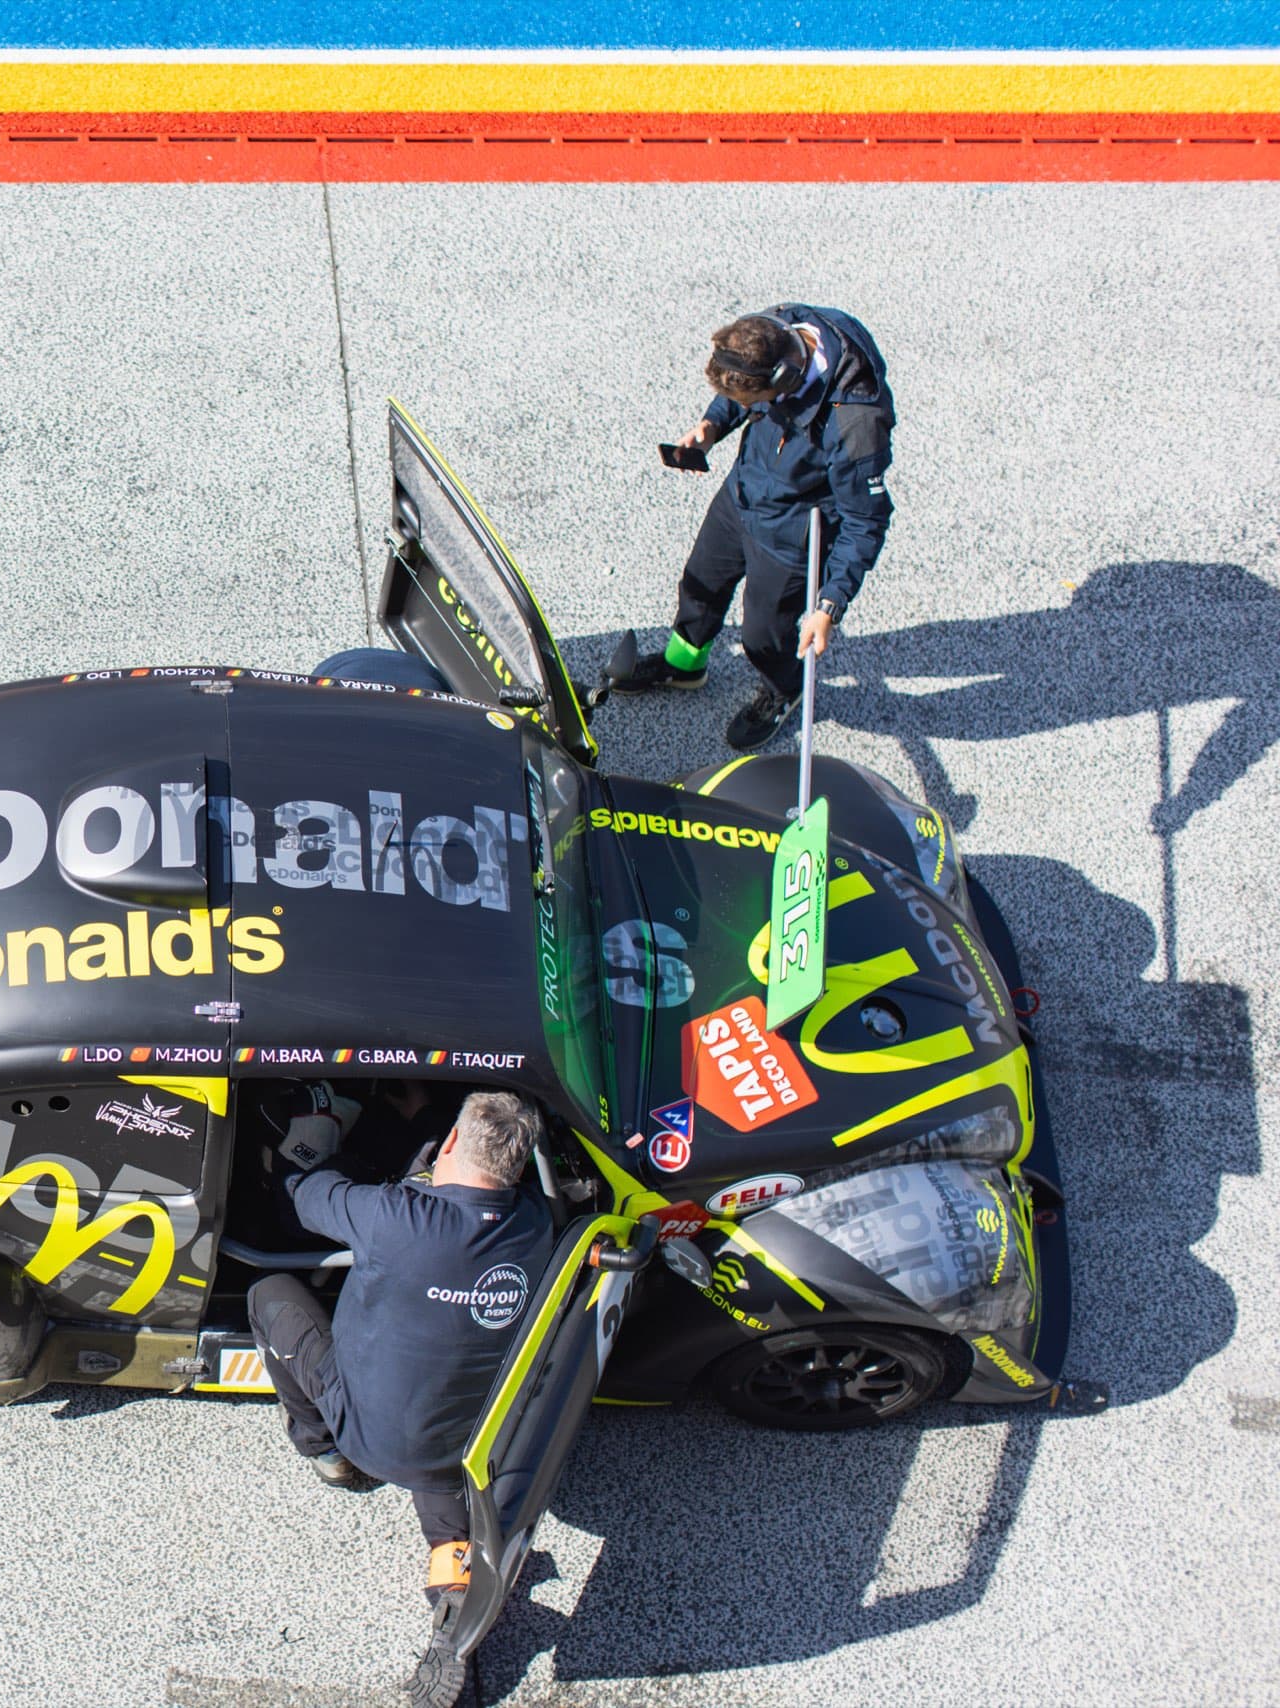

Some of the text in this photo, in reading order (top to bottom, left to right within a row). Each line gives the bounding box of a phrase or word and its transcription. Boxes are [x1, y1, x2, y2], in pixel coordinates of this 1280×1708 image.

[154, 667, 216, 677] M.ZHOU
[250, 670, 309, 685] M.BARA
[340, 679, 397, 692] G.BARA
[780, 849, 813, 983] 315
[953, 922, 1007, 1018] comtoyou
[83, 1047, 525, 1069] L.DO M.ZHOU M.BARA G.BARA F.TAQUET
[698, 1016, 775, 1122] TAPIS
[730, 1006, 800, 1106] DECO LAND
[108, 1105, 193, 1140] PHOENIX
[293, 1144, 316, 1161] OMP
[719, 1182, 789, 1209] BELL
[659, 1219, 703, 1234] PIS
[426, 1286, 519, 1308] comtoyou
[483, 1307, 514, 1317] EVENTS
[971, 1333, 1036, 1389] McDonald's
